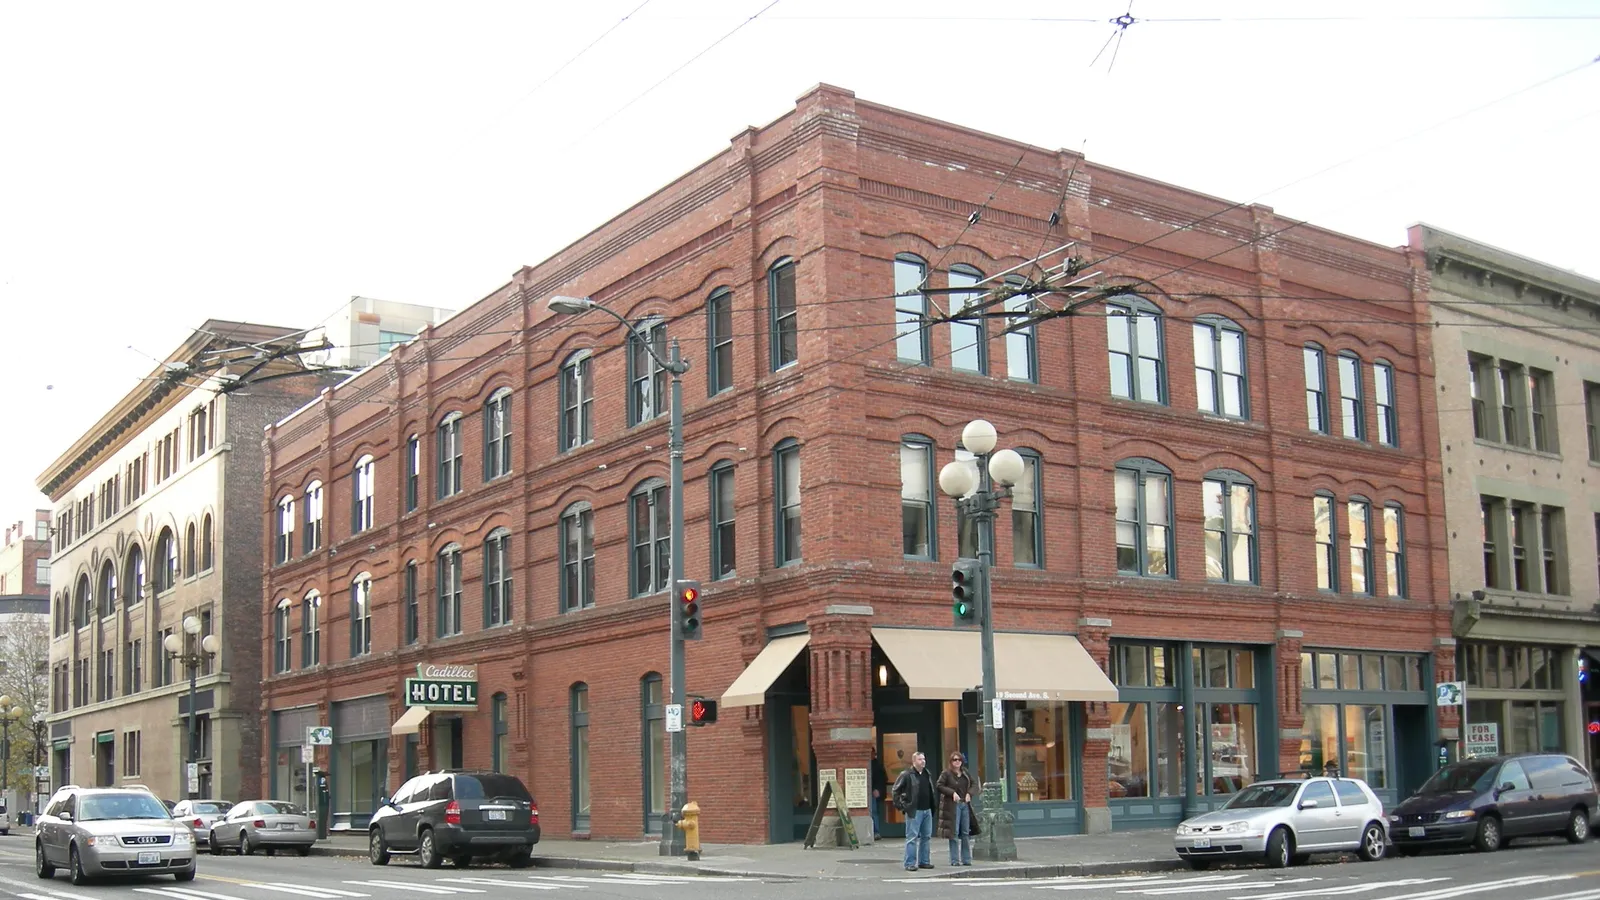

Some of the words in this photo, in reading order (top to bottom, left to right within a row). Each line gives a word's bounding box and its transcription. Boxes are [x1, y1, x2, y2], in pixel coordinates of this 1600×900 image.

[425, 665, 475, 678] Cadillac
[411, 683, 476, 702] HOTEL
[1004, 691, 1027, 699] Second
[1441, 687, 1448, 697] P
[1471, 725, 1489, 734] FOR
[1468, 733, 1496, 742] LEASE
